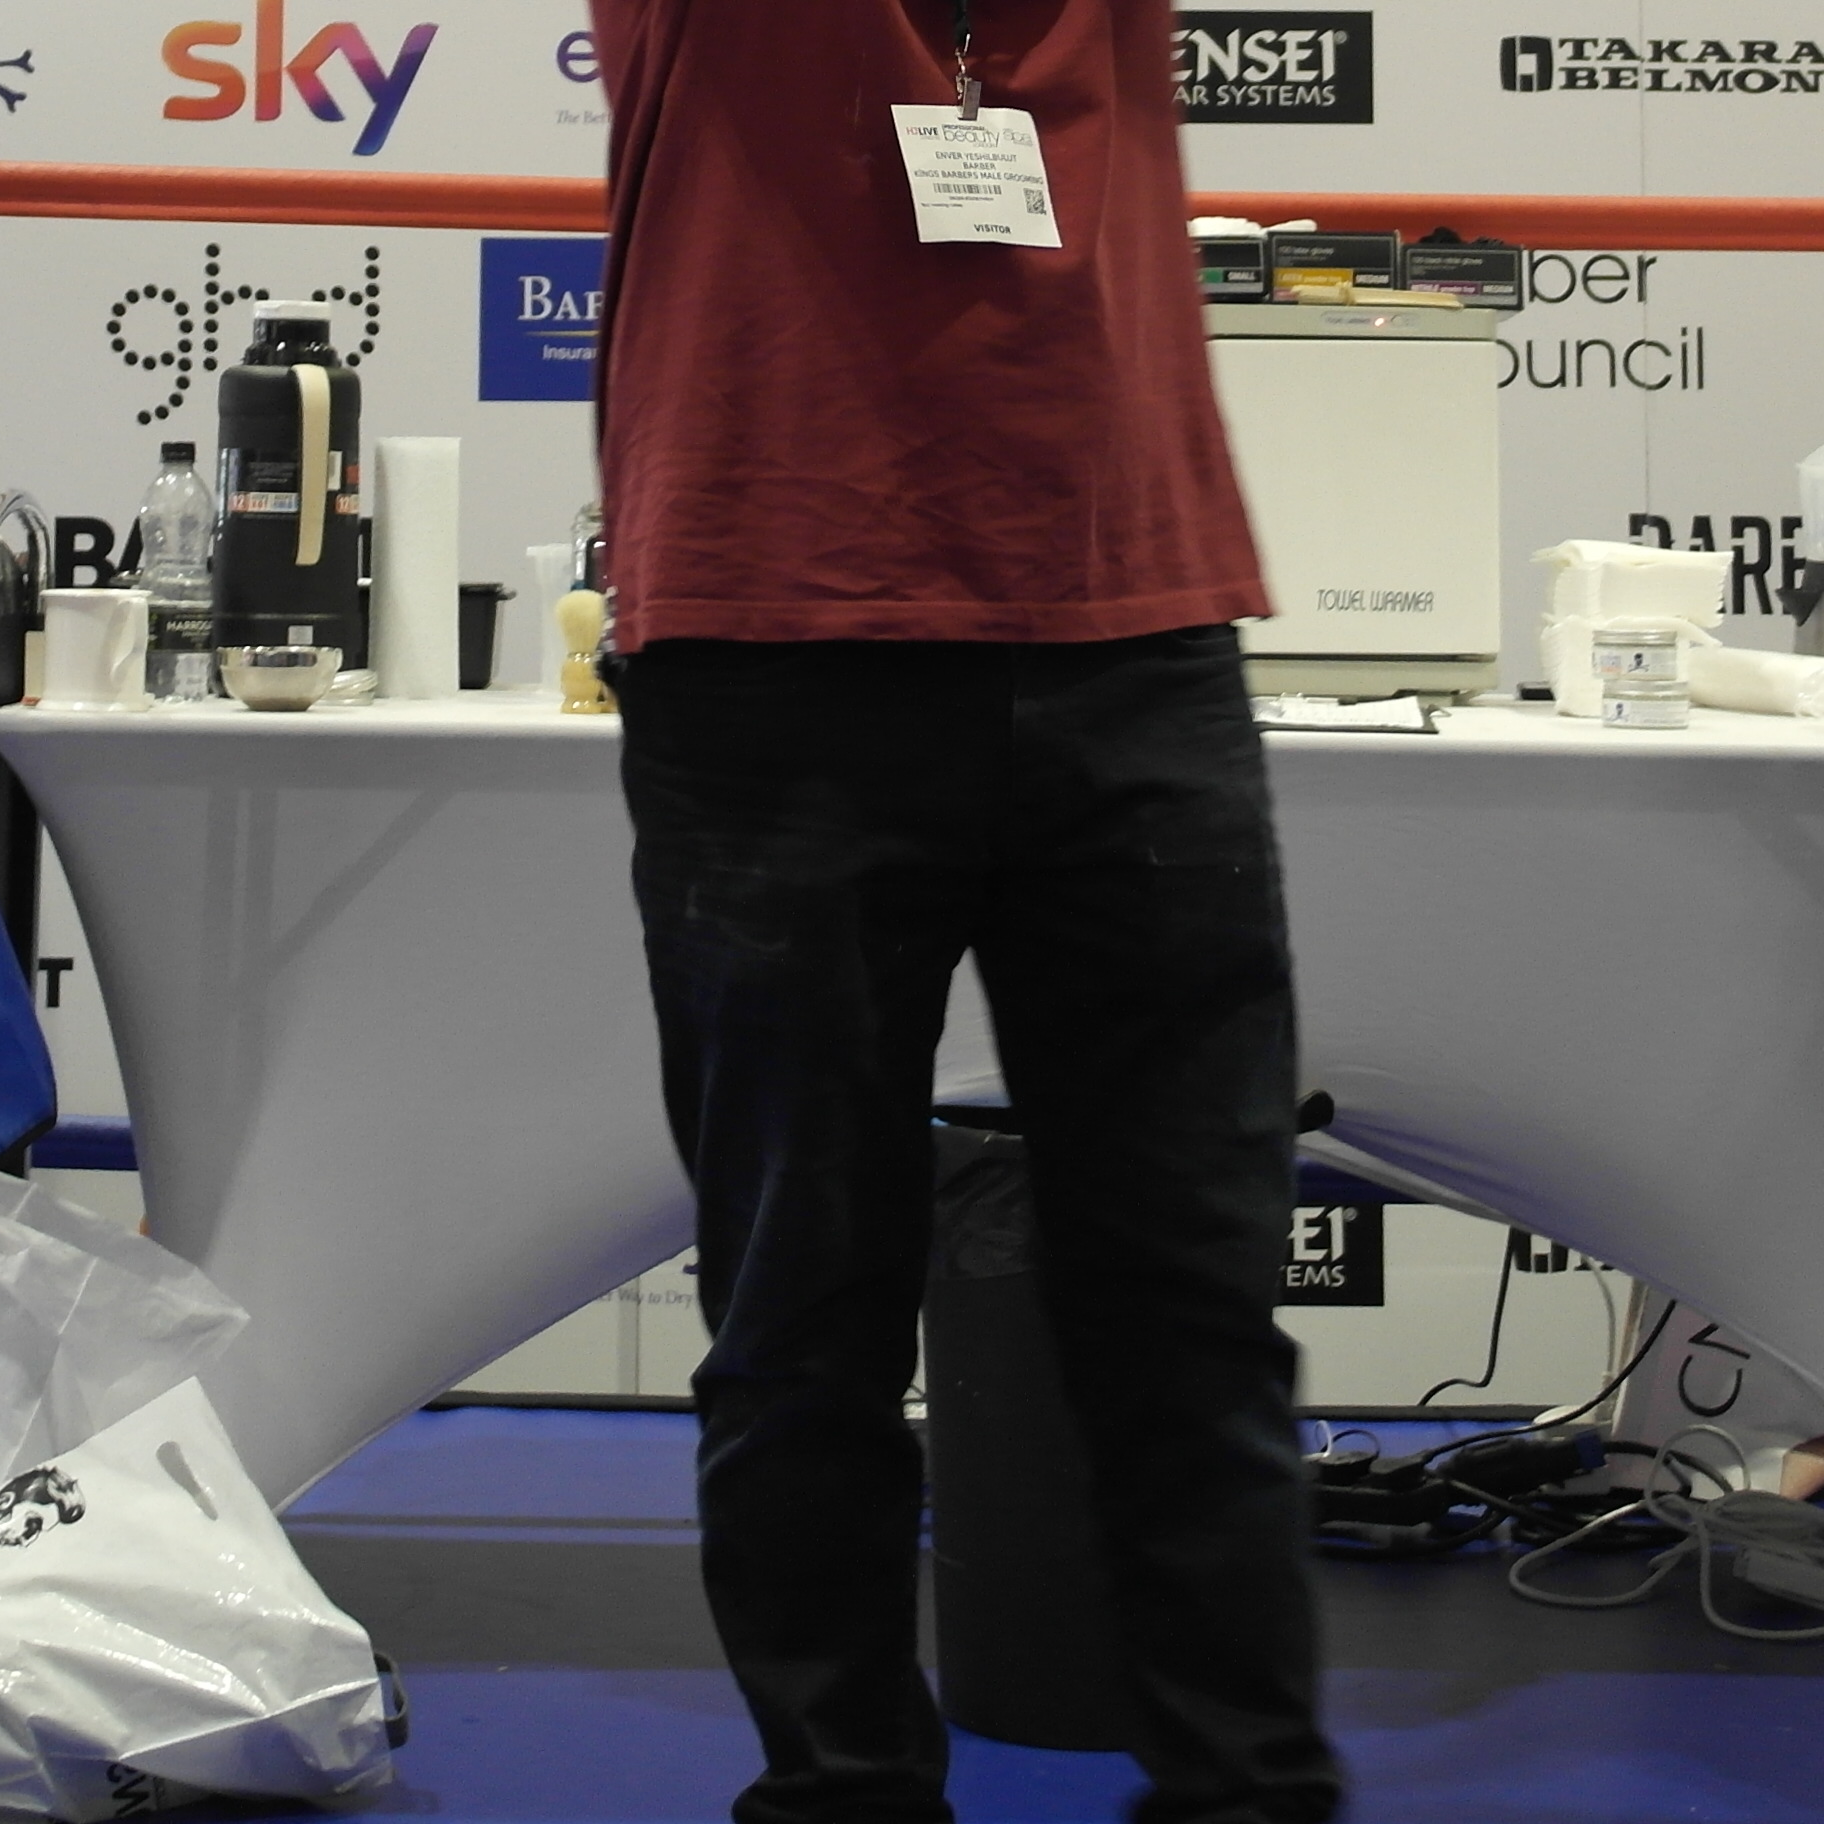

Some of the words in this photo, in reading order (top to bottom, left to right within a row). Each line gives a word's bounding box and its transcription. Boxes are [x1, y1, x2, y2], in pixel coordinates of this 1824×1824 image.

[1169, 28, 1336, 83] ENSEI
[1216, 85, 1335, 106] SYSTEMS
[974, 224, 1012, 234] VISITOR
[1317, 589, 1365, 612] TOWEL
[1370, 590, 1434, 613] WARMER
